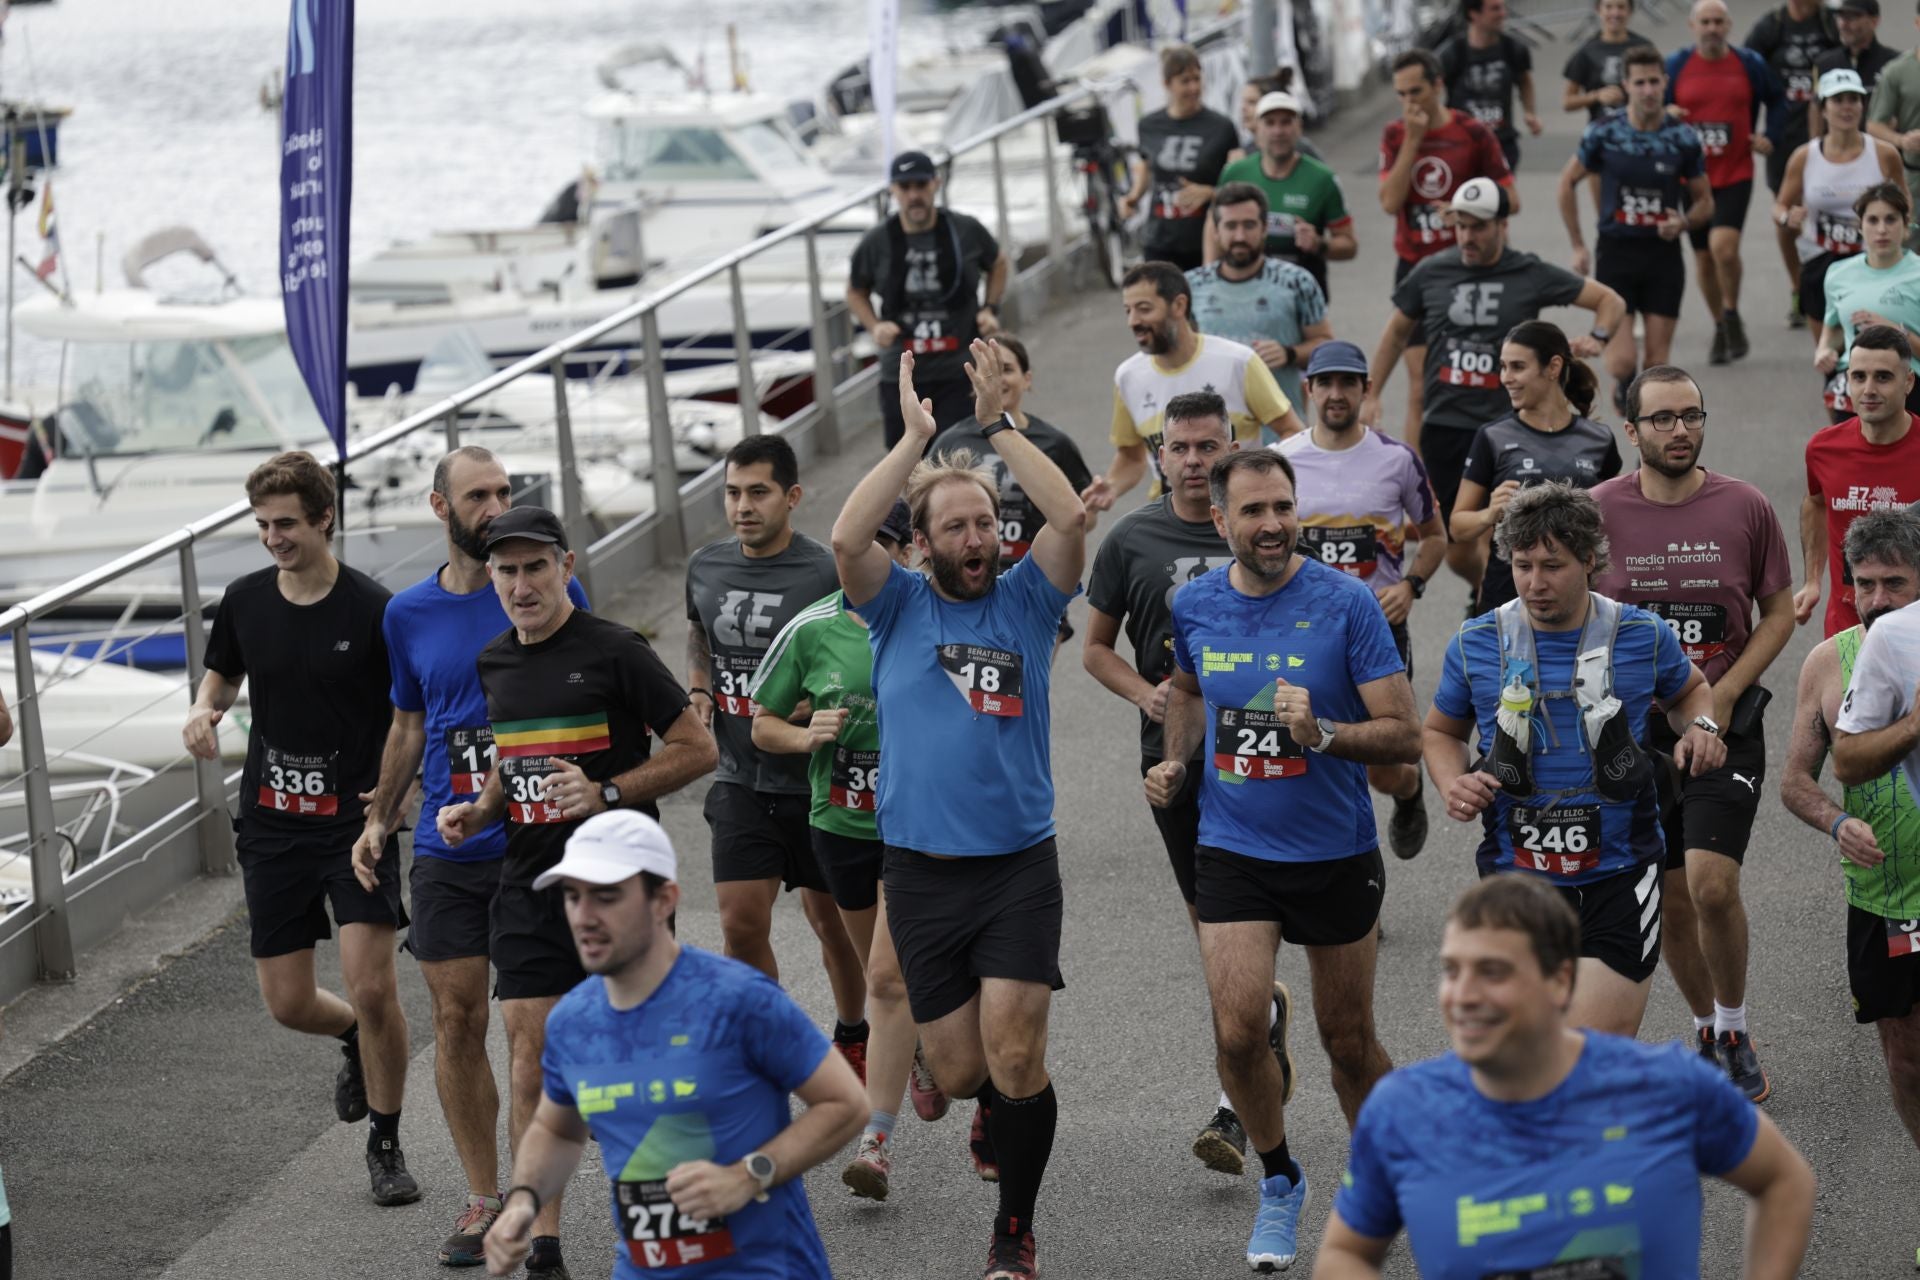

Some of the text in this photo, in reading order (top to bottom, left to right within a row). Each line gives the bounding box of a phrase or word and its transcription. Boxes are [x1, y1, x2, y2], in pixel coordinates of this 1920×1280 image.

[914, 320, 941, 339] 41
[1448, 350, 1493, 374] 100
[1849, 486, 1869, 500] 27
[1321, 541, 1357, 564] 82
[1626, 552, 1721, 565] media maratón
[1640, 579, 1668, 587] LOMEÑA
[1669, 603, 1693, 612] BEÑAT
[968, 647, 1010, 661] BEÑAT ELZO
[960, 662, 1000, 692] 18
[1245, 712, 1269, 722] BEÑAT
[1237, 729, 1280, 757] 24
[522, 757, 542, 767] BEÑAT
[852, 752, 876, 761] BEÑAT
[269, 765, 325, 796] 336
[1563, 809, 1584, 817] ELZO
[1520, 825, 1588, 853] 246
